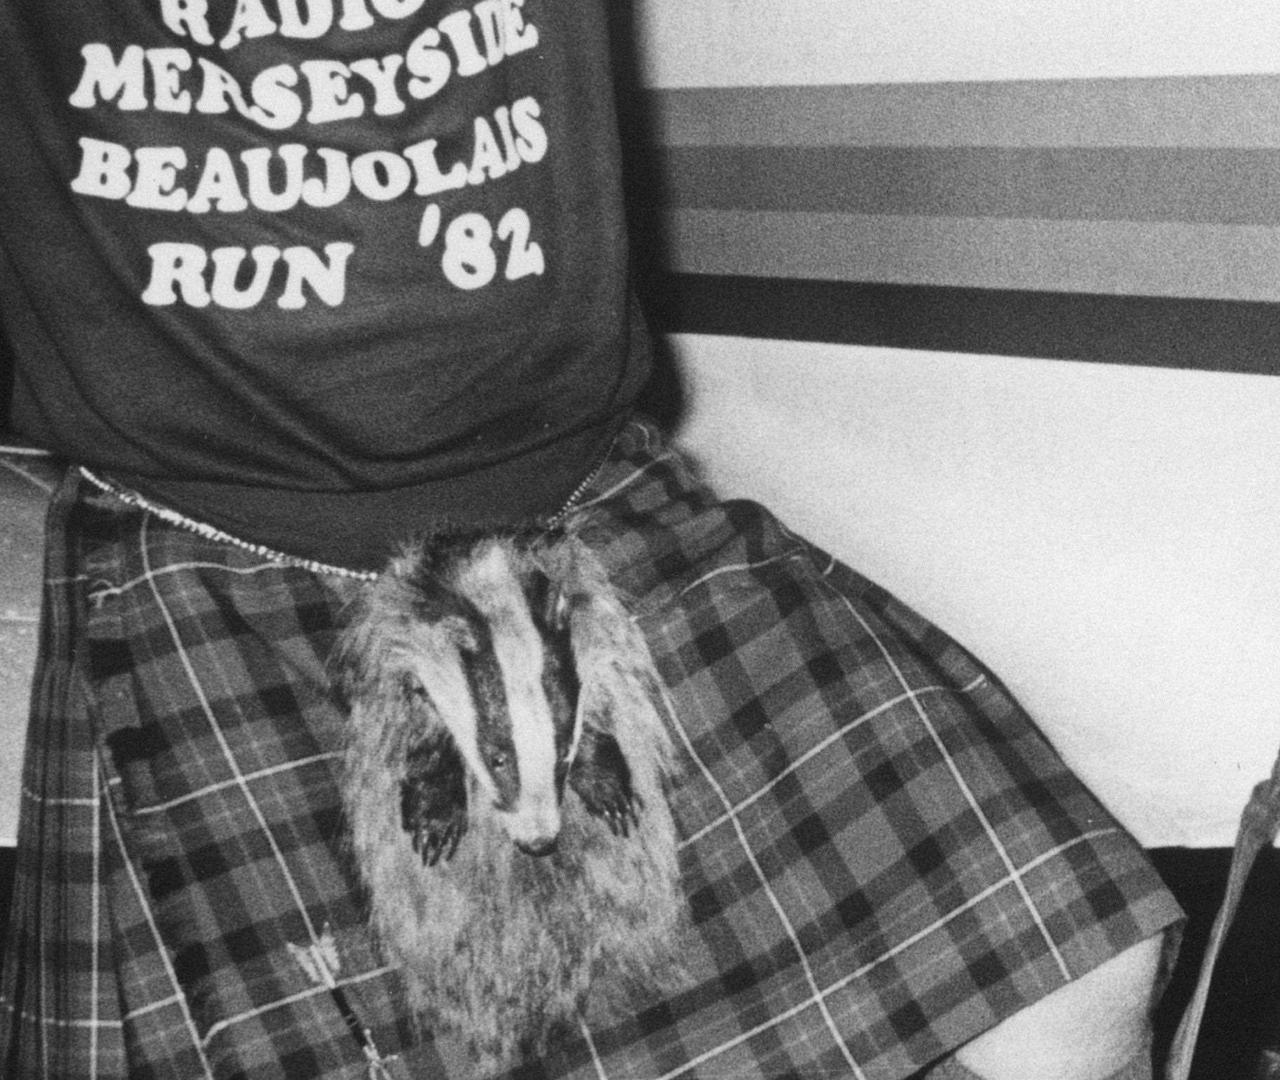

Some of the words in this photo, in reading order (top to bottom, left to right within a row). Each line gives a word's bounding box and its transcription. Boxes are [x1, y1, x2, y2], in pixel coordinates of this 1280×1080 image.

[70, 95, 549, 215] BEAUJOLAIS
[141, 240, 356, 311] RUN
[417, 202, 546, 291] '82
